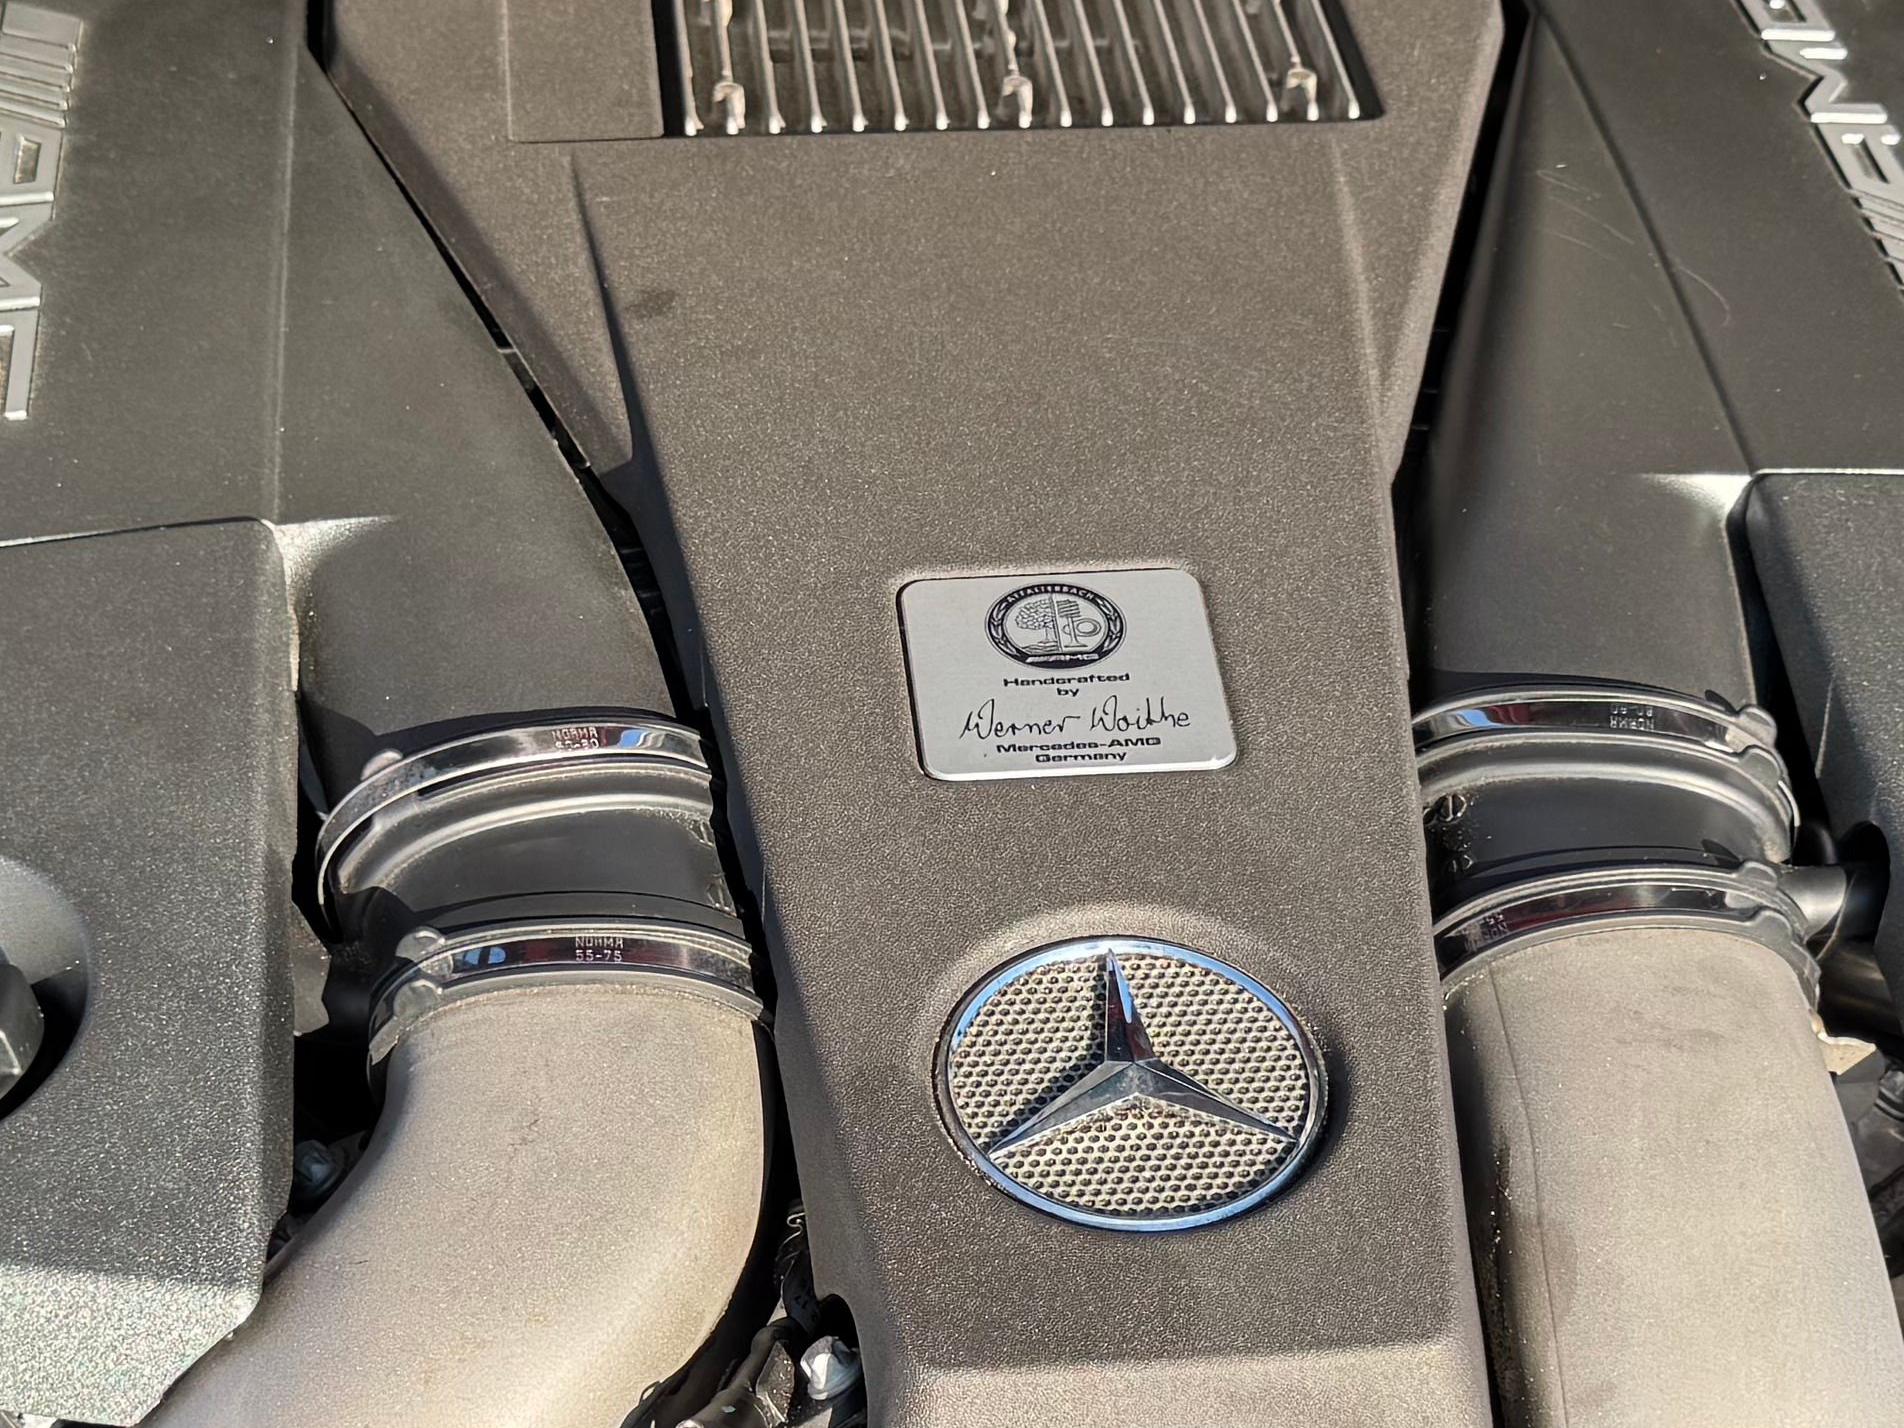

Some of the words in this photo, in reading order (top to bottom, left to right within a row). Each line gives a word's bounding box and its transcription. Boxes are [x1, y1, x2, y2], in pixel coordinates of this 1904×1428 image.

[1002, 672, 1131, 688] Handcrafted
[1056, 685, 1080, 698] by
[995, 736, 1162, 754] Mercedes-AMG
[1035, 749, 1128, 763] Germany
[575, 949, 623, 963] 55-75
